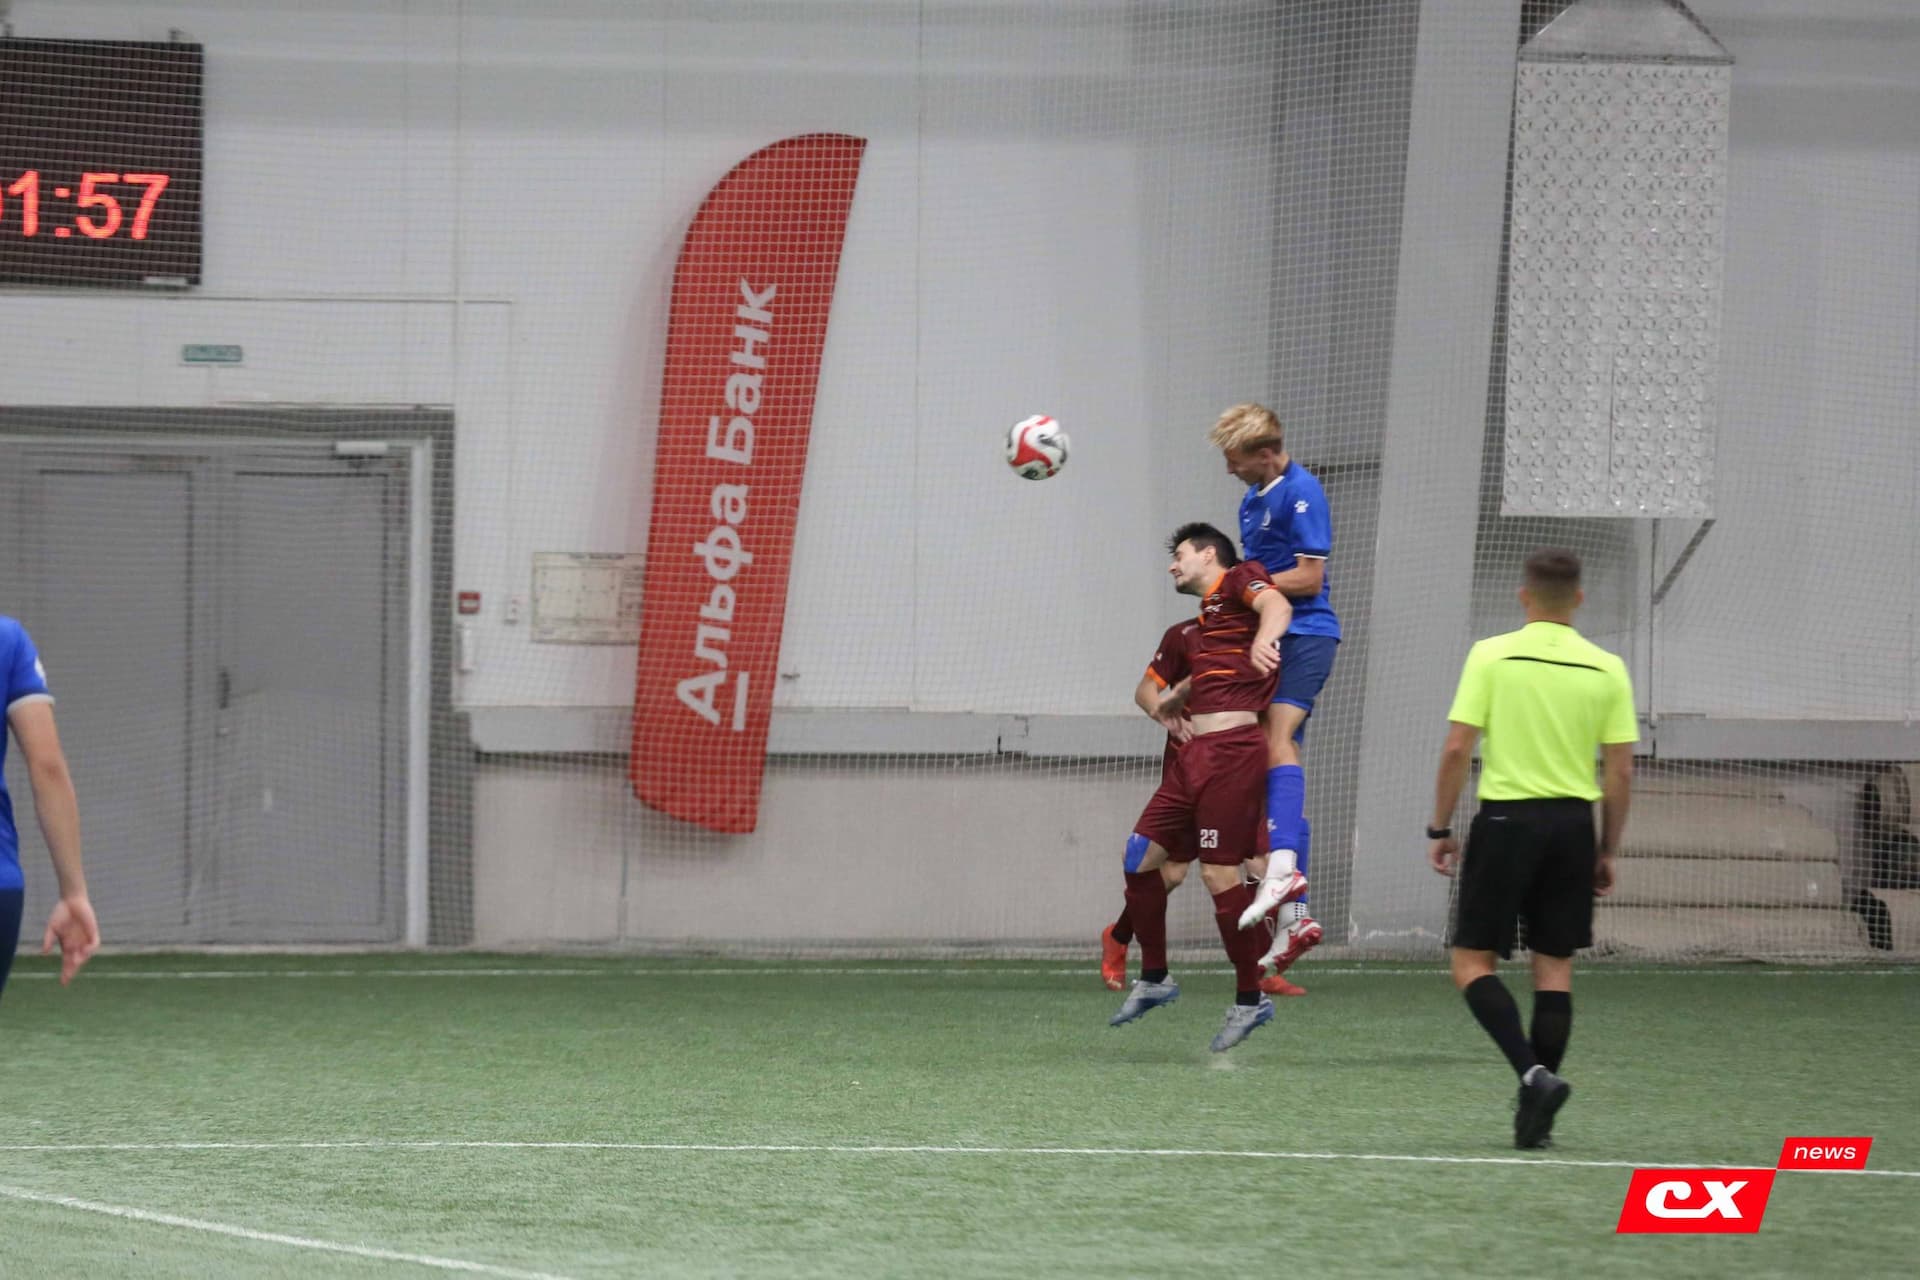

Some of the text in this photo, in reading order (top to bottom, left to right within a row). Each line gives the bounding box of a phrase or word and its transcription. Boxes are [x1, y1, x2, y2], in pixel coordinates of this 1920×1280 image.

[0, 171, 170, 240] 1:57
[675, 278, 777, 728] Альфа Банк
[1200, 828, 1219, 849] 23
